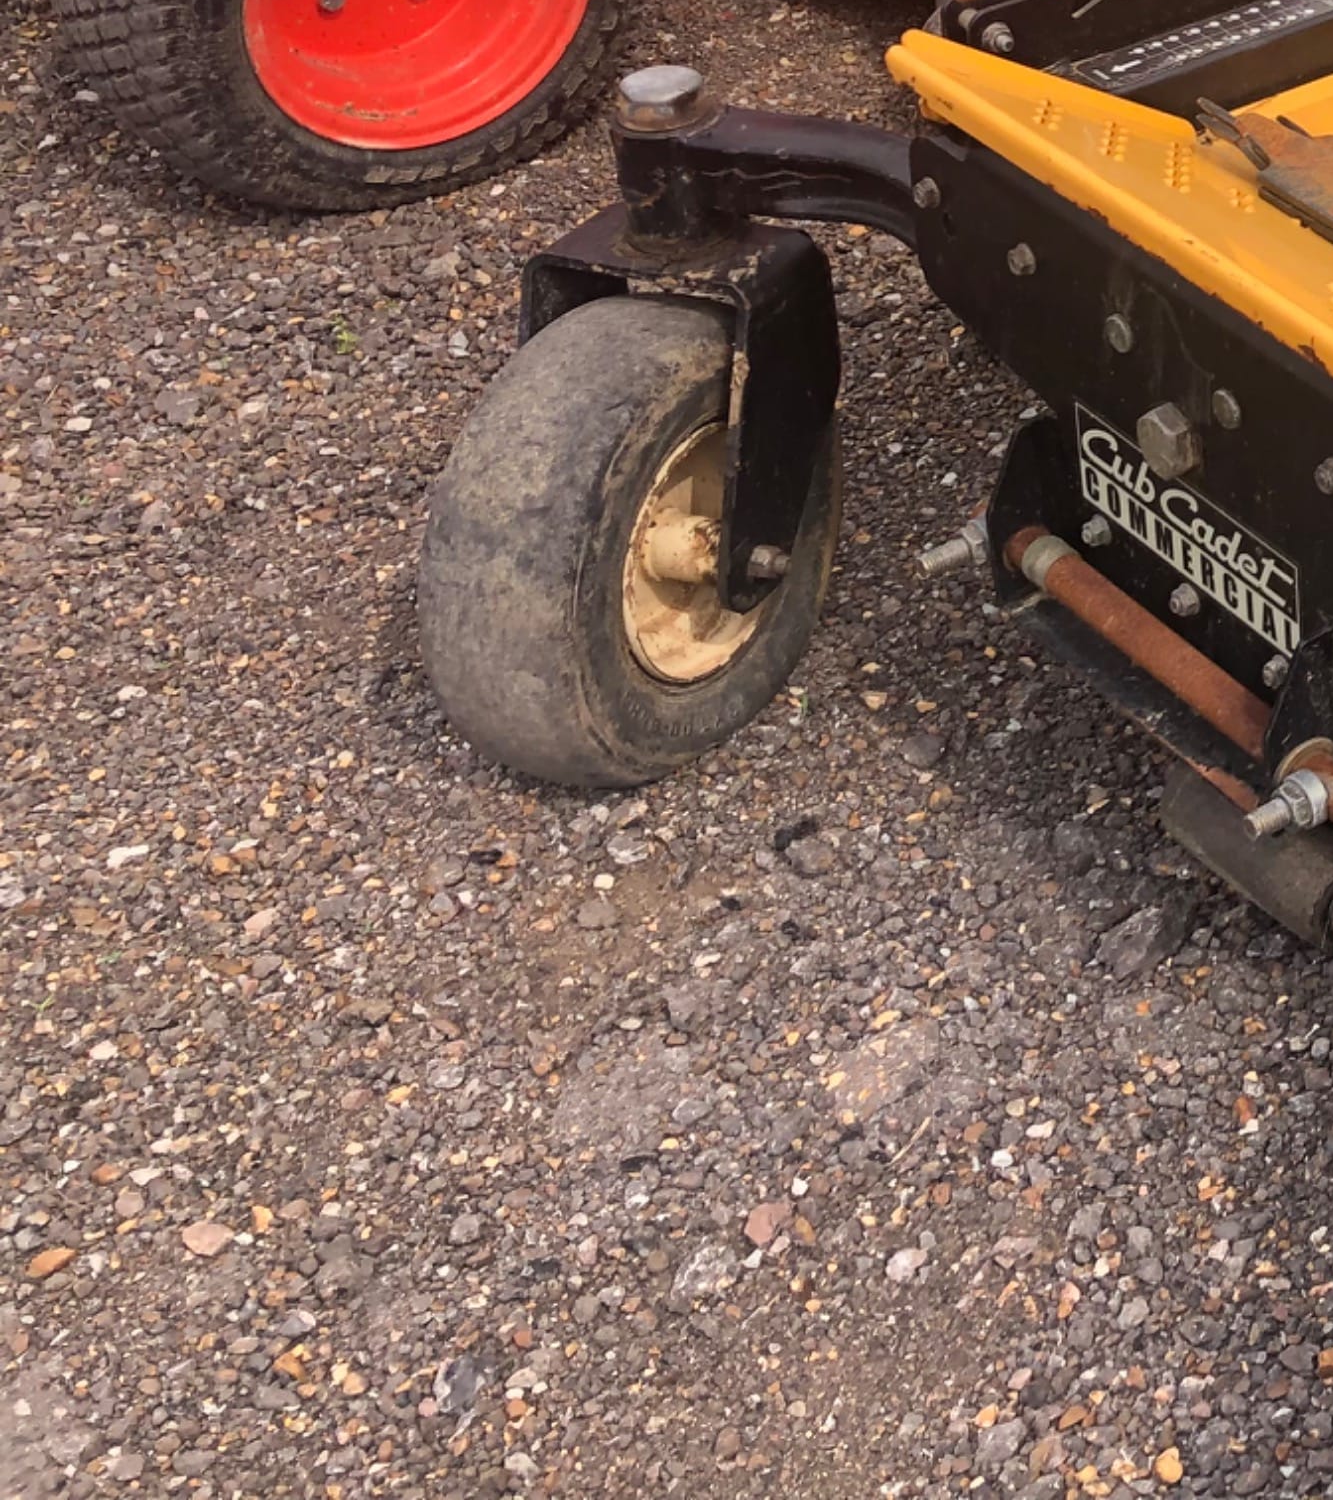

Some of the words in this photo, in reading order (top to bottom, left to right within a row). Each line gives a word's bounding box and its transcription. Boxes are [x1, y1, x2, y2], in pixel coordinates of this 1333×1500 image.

[1081, 429, 1156, 503] Cub
[1160, 489, 1295, 608] Cadet
[1085, 466, 1296, 652] COMMERCIAL
